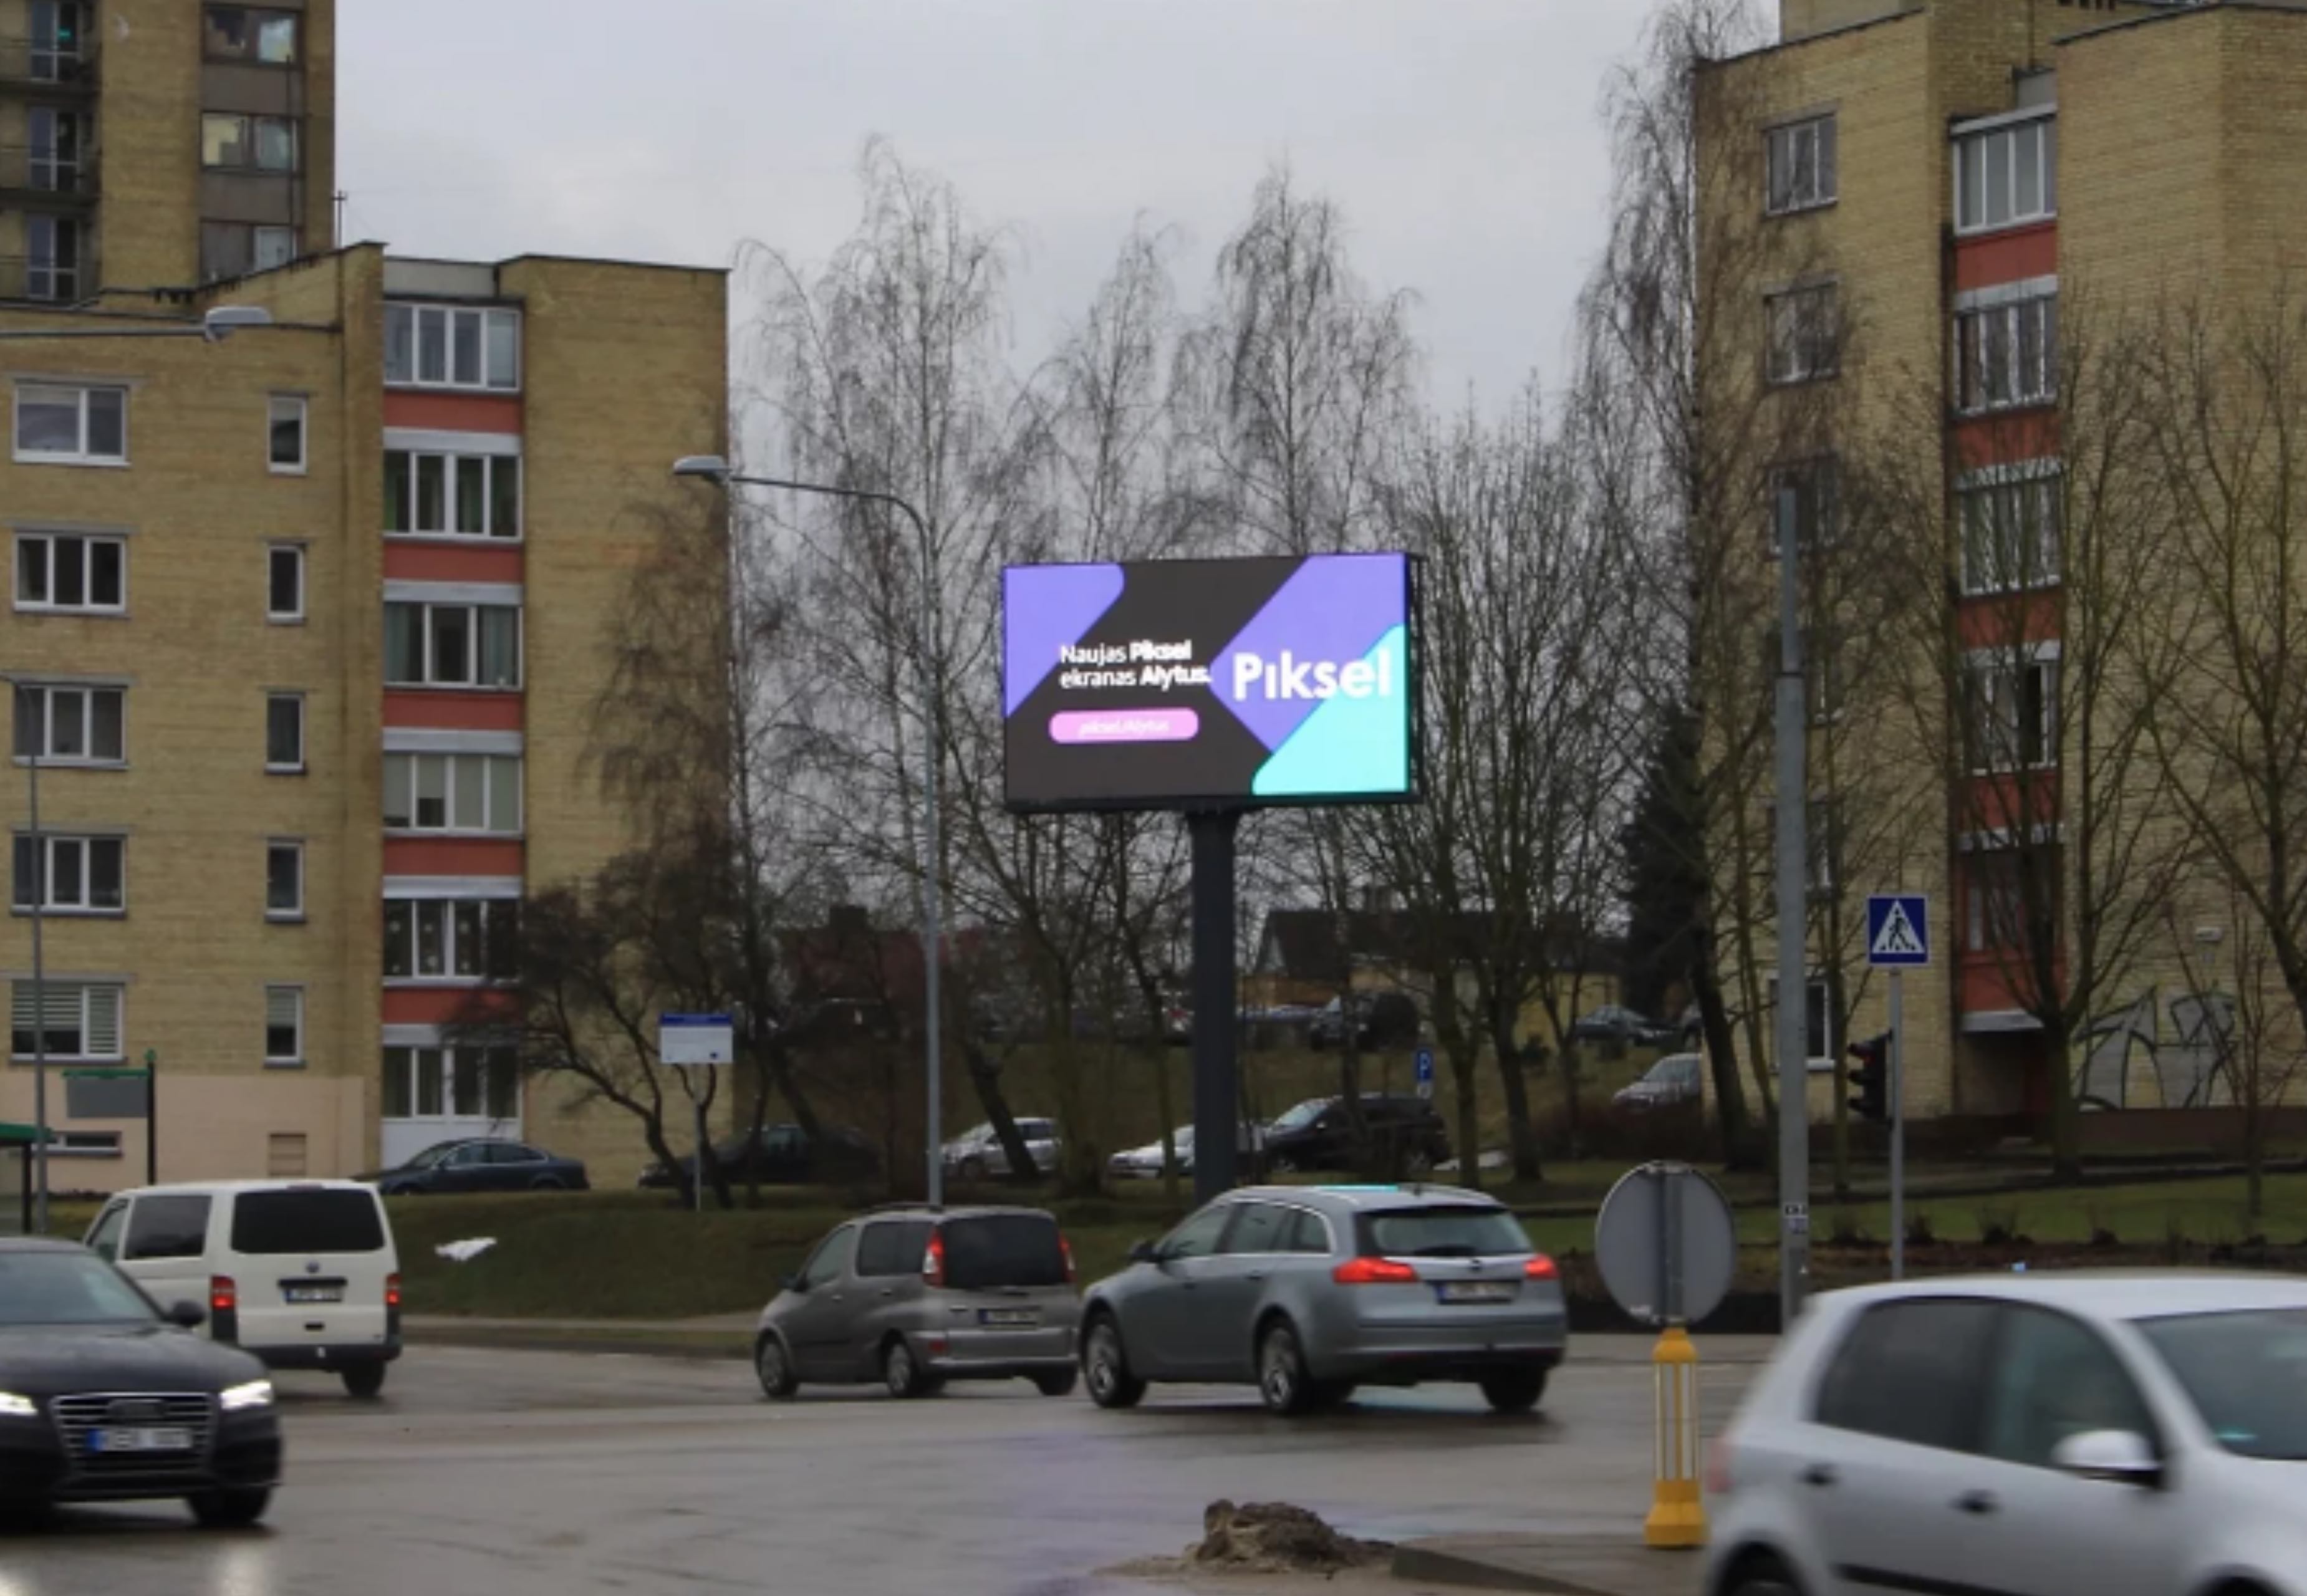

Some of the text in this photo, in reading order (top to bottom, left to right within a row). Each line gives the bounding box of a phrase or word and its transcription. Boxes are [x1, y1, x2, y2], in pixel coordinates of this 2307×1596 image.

[1060, 638, 1193, 667] Naujas Piksel
[1060, 668, 1137, 688] ekranas
[1233, 648, 1392, 702] Piksel
